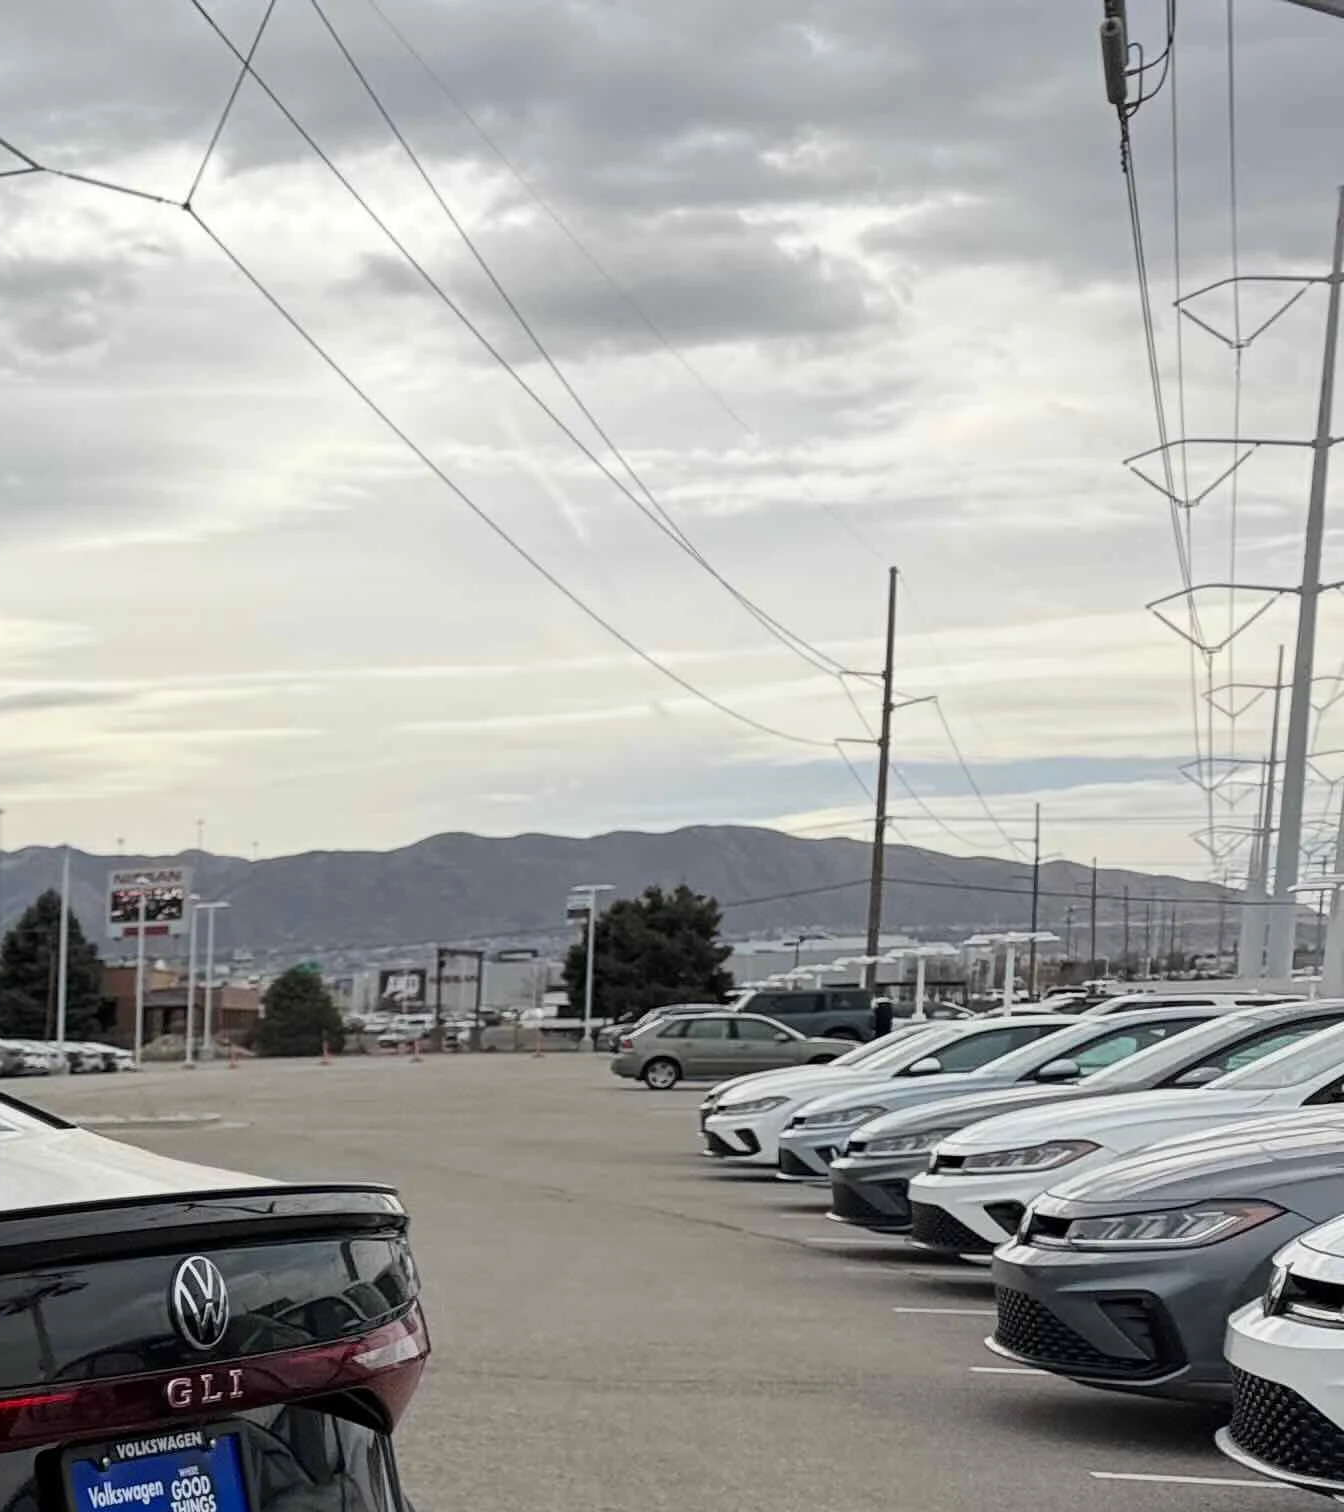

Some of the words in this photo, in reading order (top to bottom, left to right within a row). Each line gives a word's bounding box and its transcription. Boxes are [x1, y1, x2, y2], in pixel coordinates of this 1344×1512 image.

[167, 1369, 244, 1409] GLI
[116, 1431, 203, 1460] VOLKSWAGEN
[88, 1480, 164, 1509] Volkswagen
[171, 1475, 212, 1501] GOOD
